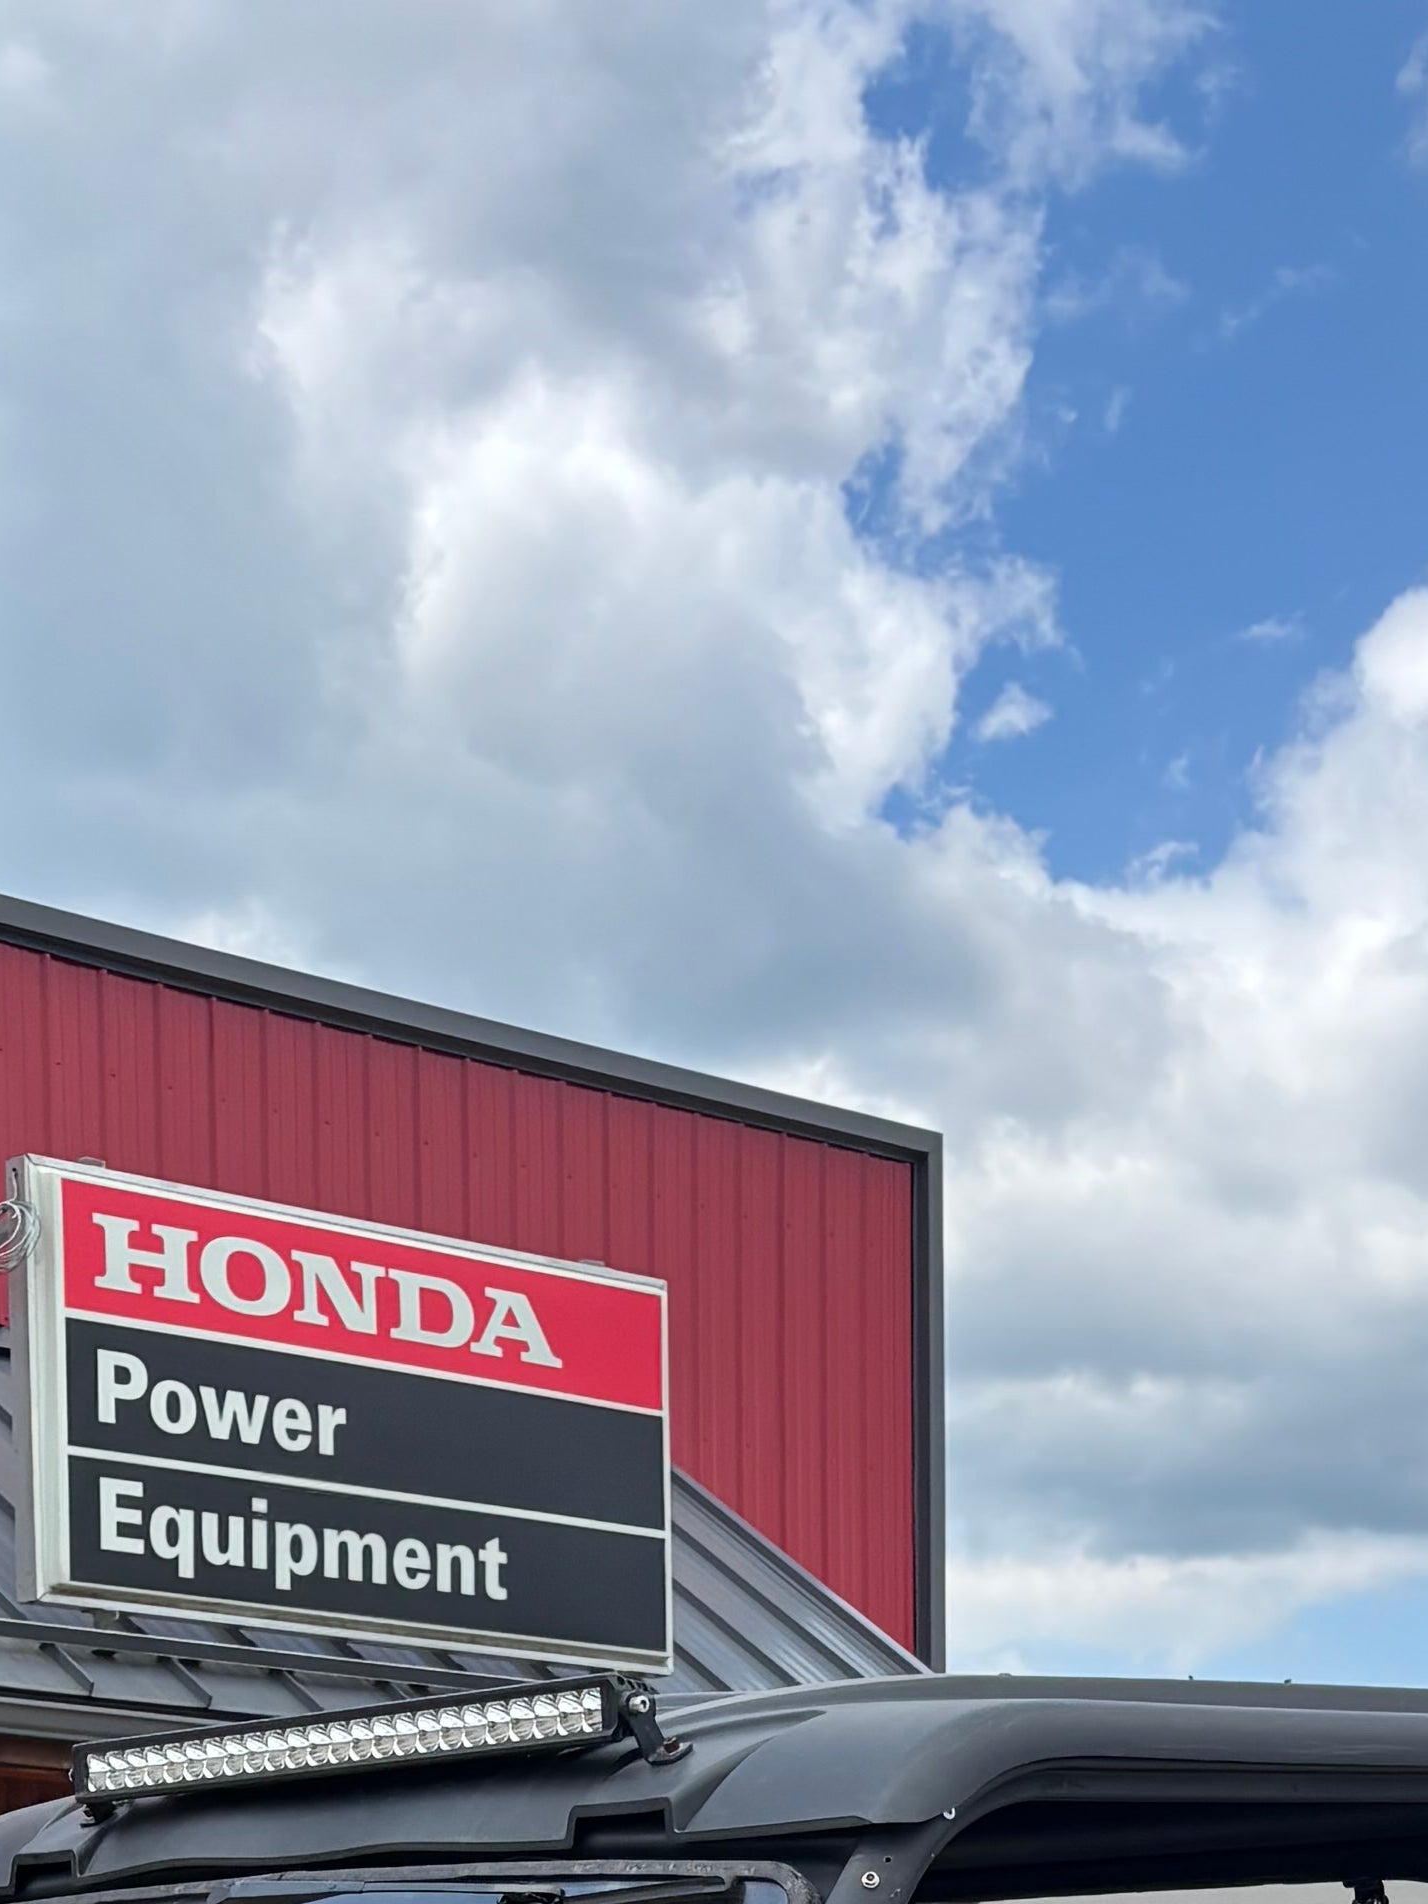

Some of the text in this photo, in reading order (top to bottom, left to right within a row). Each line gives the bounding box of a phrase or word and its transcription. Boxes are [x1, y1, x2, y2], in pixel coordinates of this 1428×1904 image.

[91, 1212, 563, 1369] HONDA
[96, 1348, 347, 1456] Power
[98, 1477, 509, 1601] Equipment
